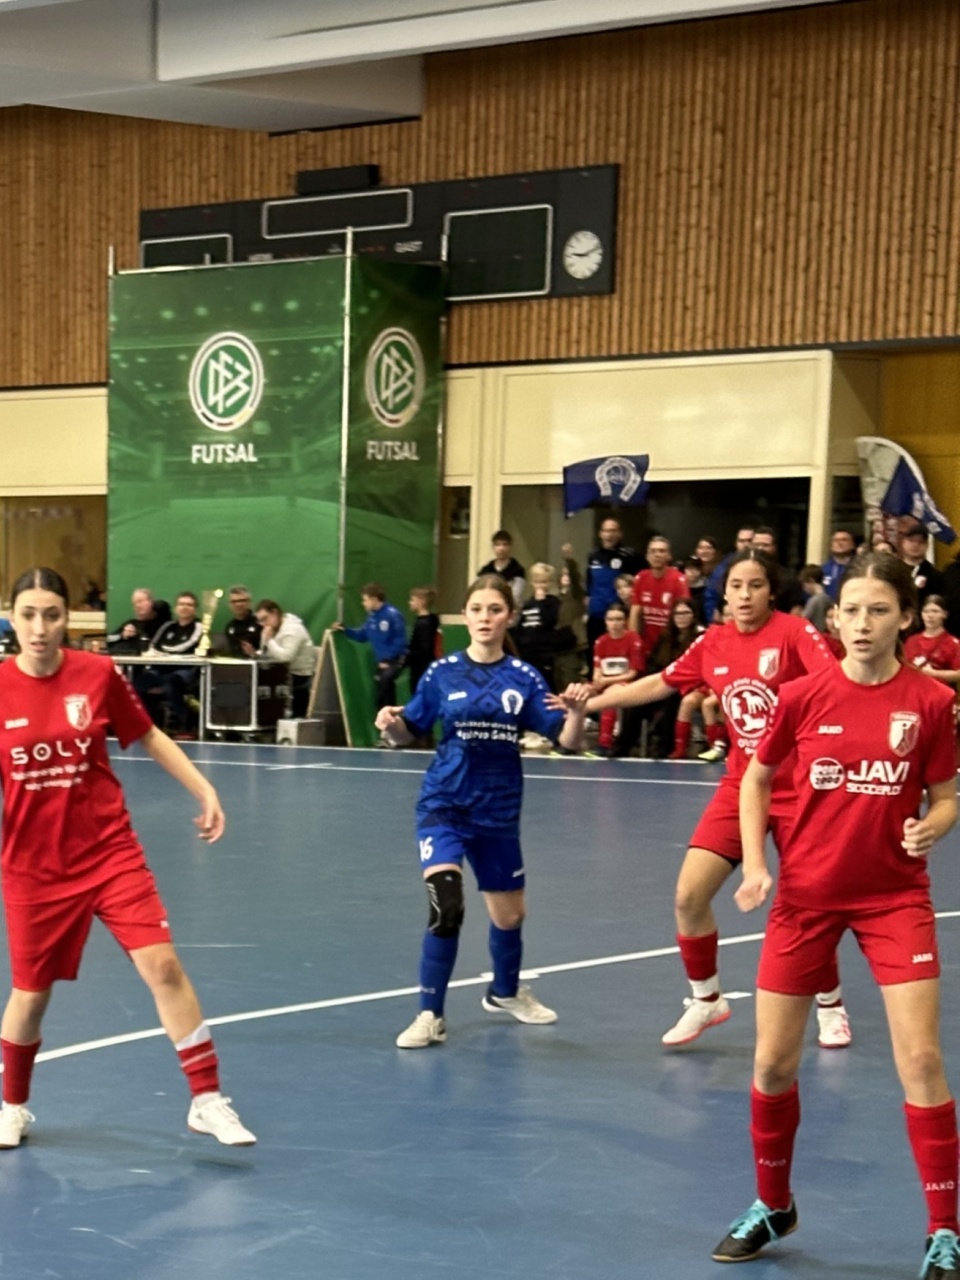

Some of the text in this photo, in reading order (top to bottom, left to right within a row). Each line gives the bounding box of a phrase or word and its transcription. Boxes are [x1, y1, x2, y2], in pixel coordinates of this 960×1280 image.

[191, 442, 258, 464] FUTSAL
[366, 440, 420, 461] FUTSAL
[10, 737, 92, 765] SOLY
[847, 760, 910, 783] JAVI
[419, 836, 433, 862] 16
[925, 1180, 955, 1191] JAKO
